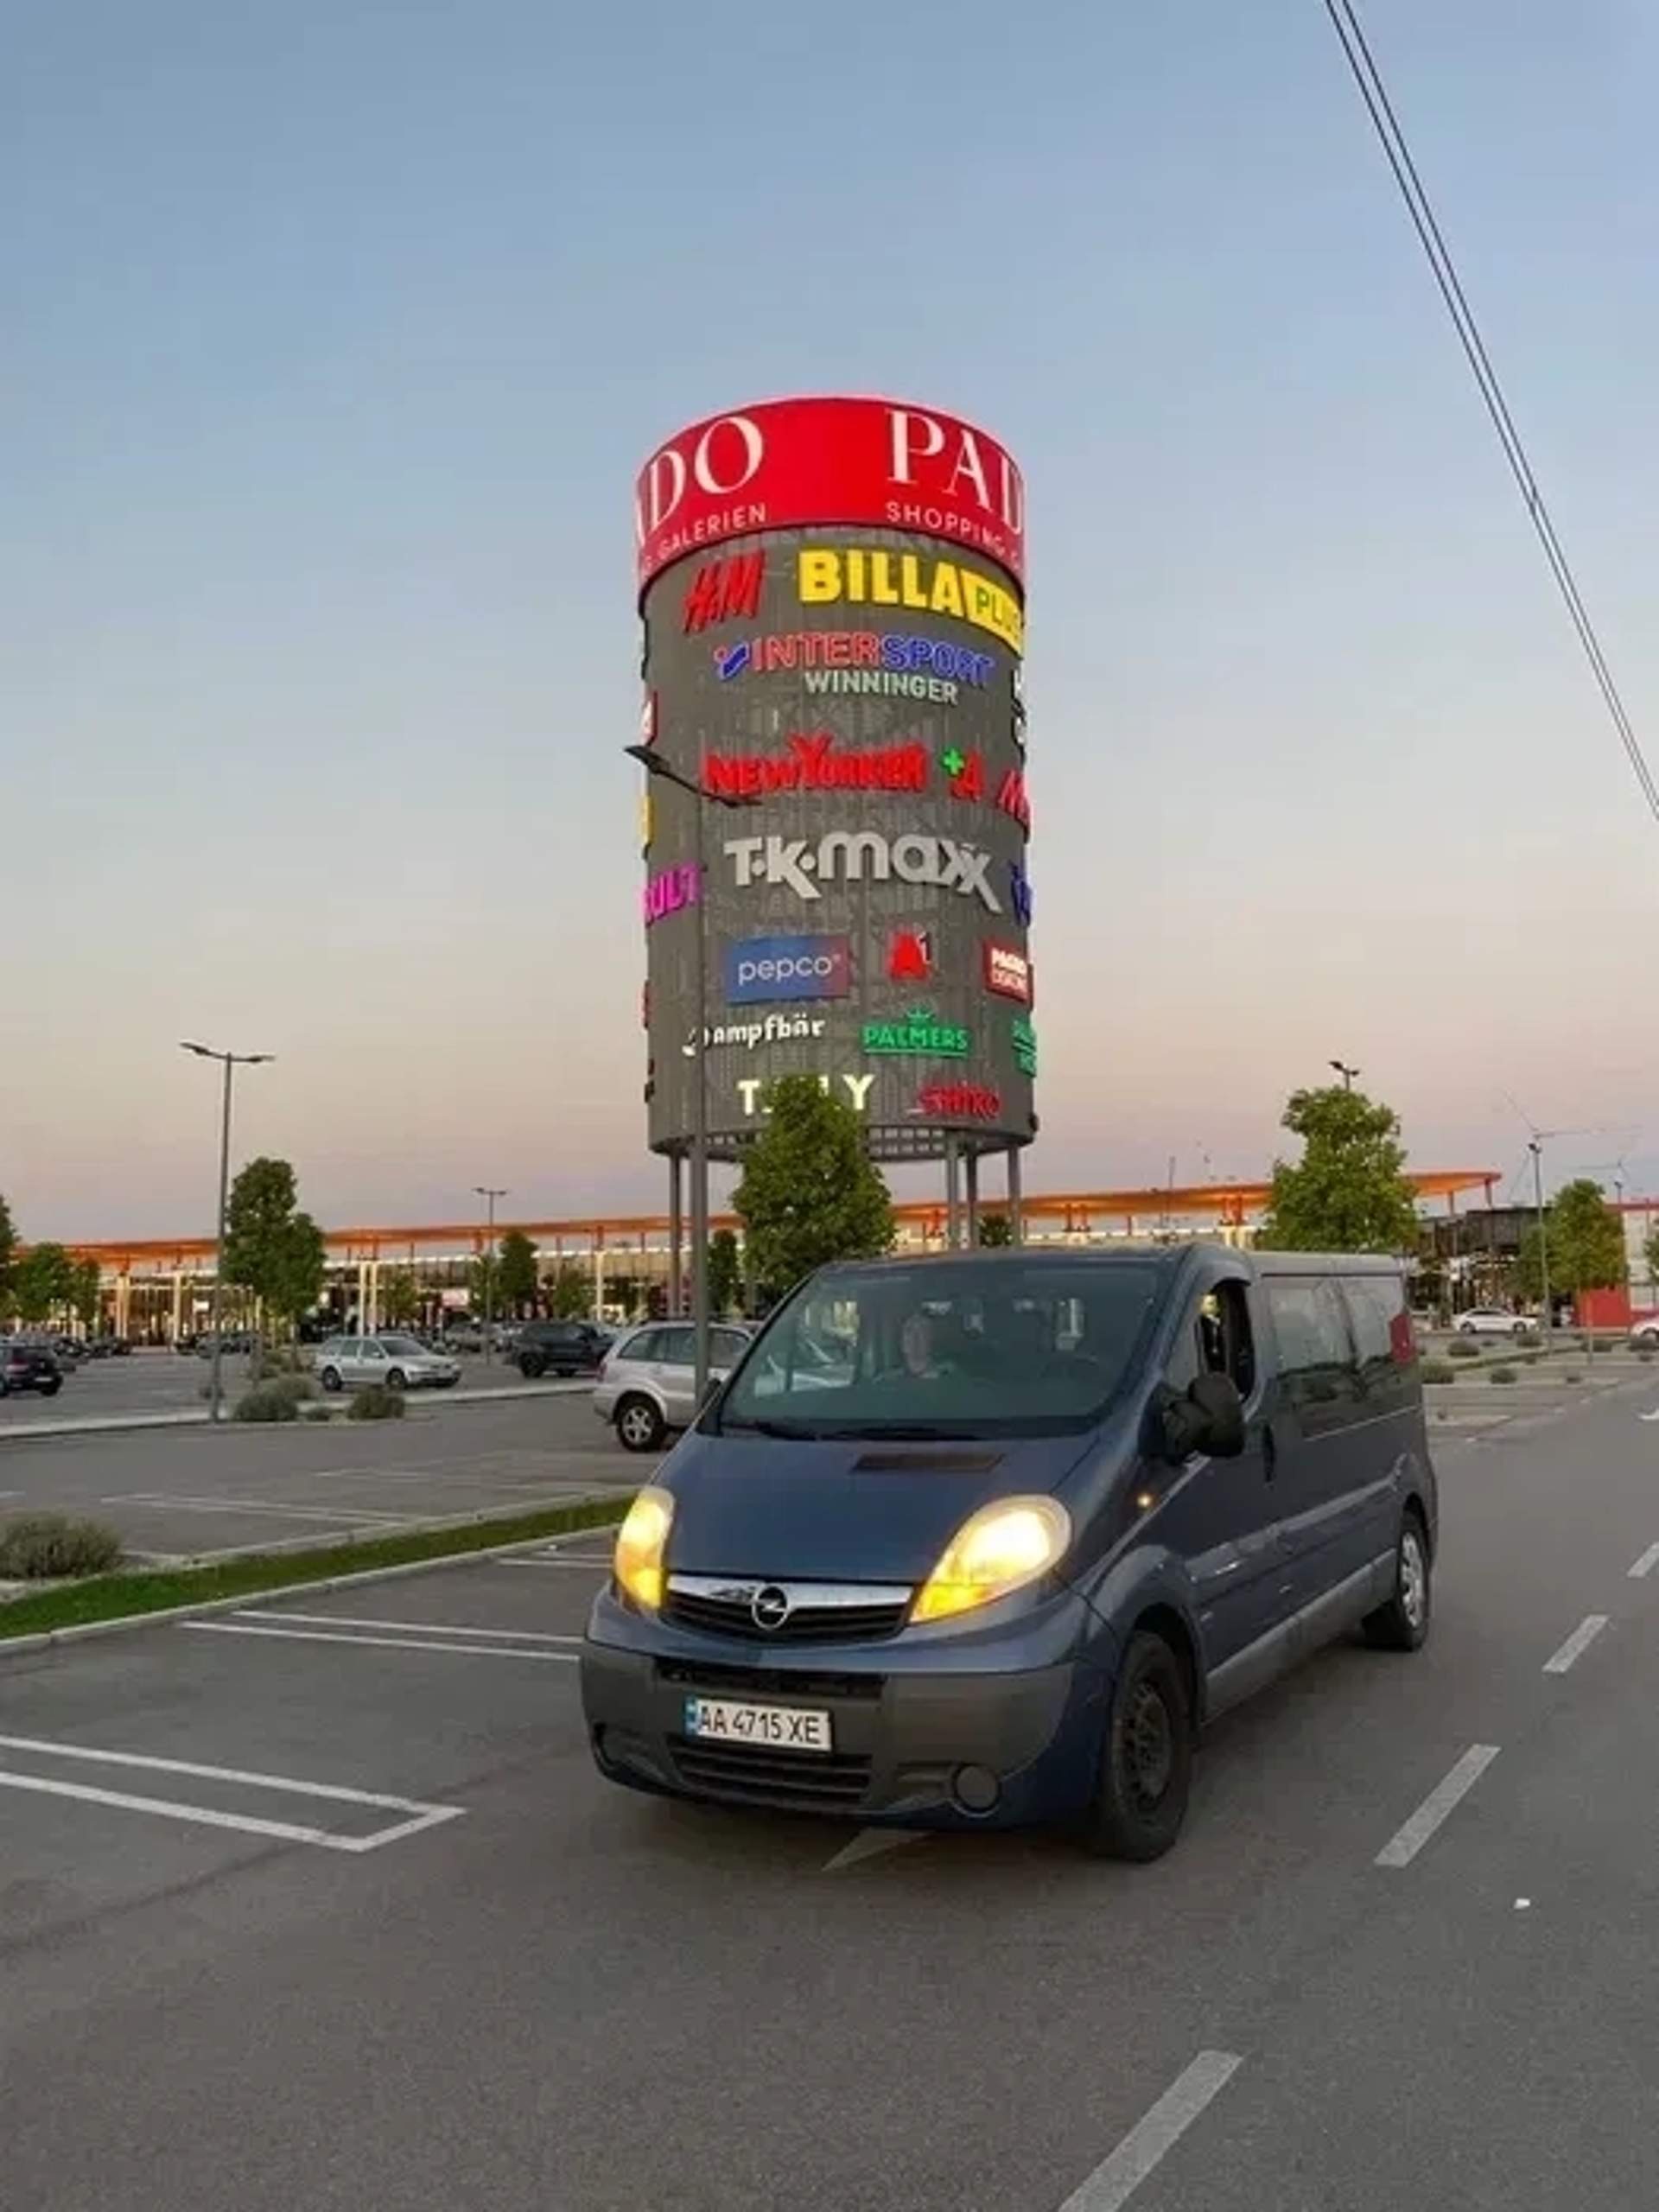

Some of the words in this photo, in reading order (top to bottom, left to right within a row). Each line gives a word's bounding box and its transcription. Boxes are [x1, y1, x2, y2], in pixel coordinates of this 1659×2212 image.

[656, 502, 766, 560] GALERIEN
[885, 499, 1006, 557] SHOPPING
[798, 548, 963, 618] BILLA
[752, 632, 995, 684] INTERSPORT
[804, 671, 958, 706] WINNINGER
[738, 954, 833, 986] pepco
[864, 1025, 968, 1049] PALMERS
[699, 1707, 728, 1734] AA
[733, 1710, 782, 1738] 4715
[787, 1715, 820, 1744] XE
